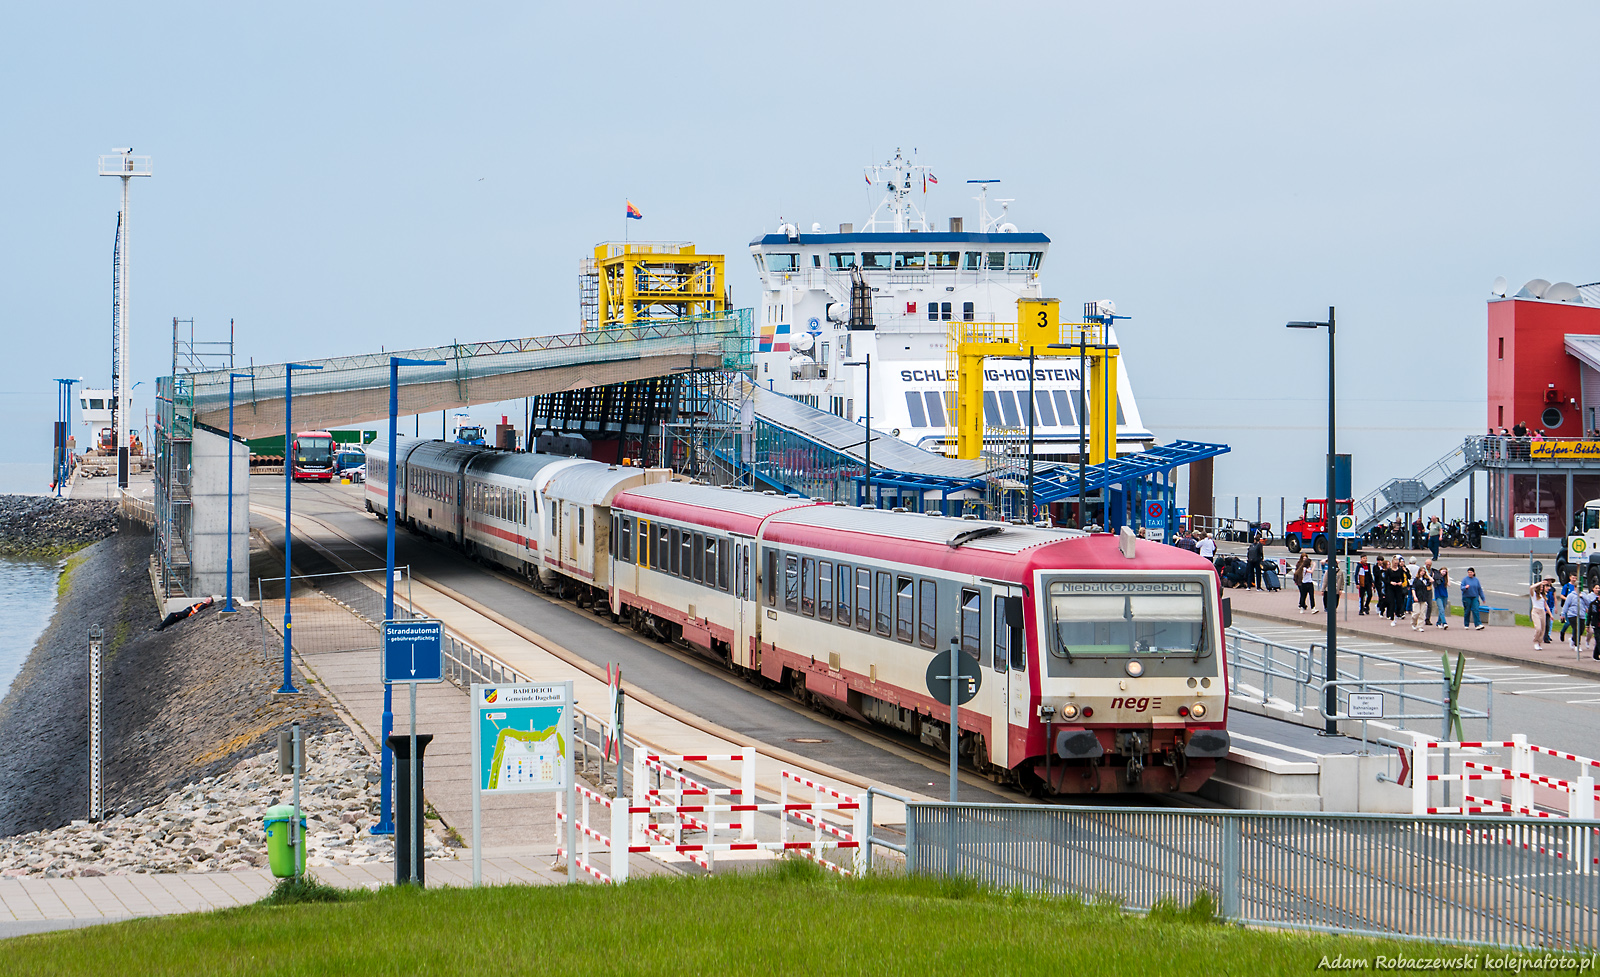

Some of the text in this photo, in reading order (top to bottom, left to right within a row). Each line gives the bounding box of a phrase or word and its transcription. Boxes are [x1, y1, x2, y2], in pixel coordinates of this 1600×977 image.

[1037, 311, 1048, 328] 3
[900, 369, 1081, 382] SCHLEIG-HOLSTEIN
[386, 627, 439, 635] Strandautomat
[535, 694, 561, 702] Dagebüll
[1110, 697, 1150, 713] neg
